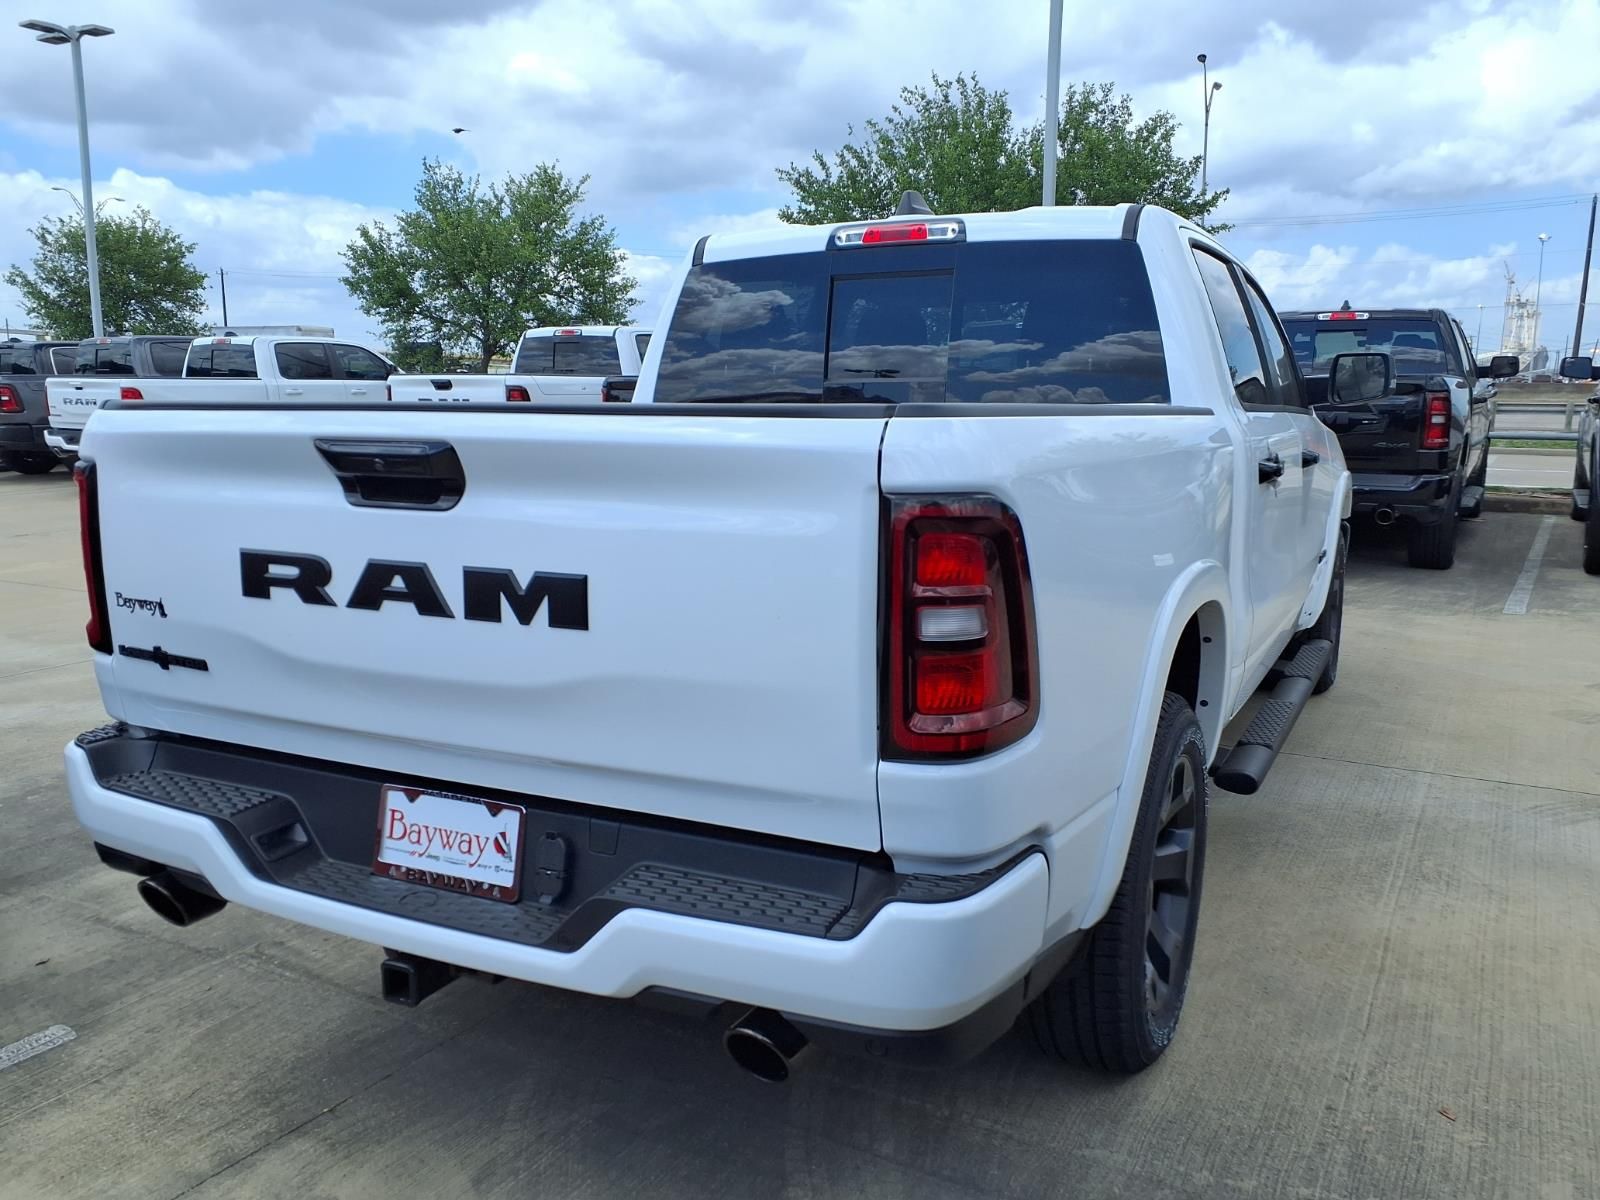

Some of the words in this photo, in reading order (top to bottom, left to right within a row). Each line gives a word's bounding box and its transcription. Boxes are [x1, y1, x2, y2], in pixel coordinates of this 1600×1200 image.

[63, 397, 97, 406] RAM
[240, 548, 589, 631] RAM
[115, 592, 160, 616] Bayway
[386, 809, 489, 867] Bayway
[408, 869, 478, 893] BAYWAY
